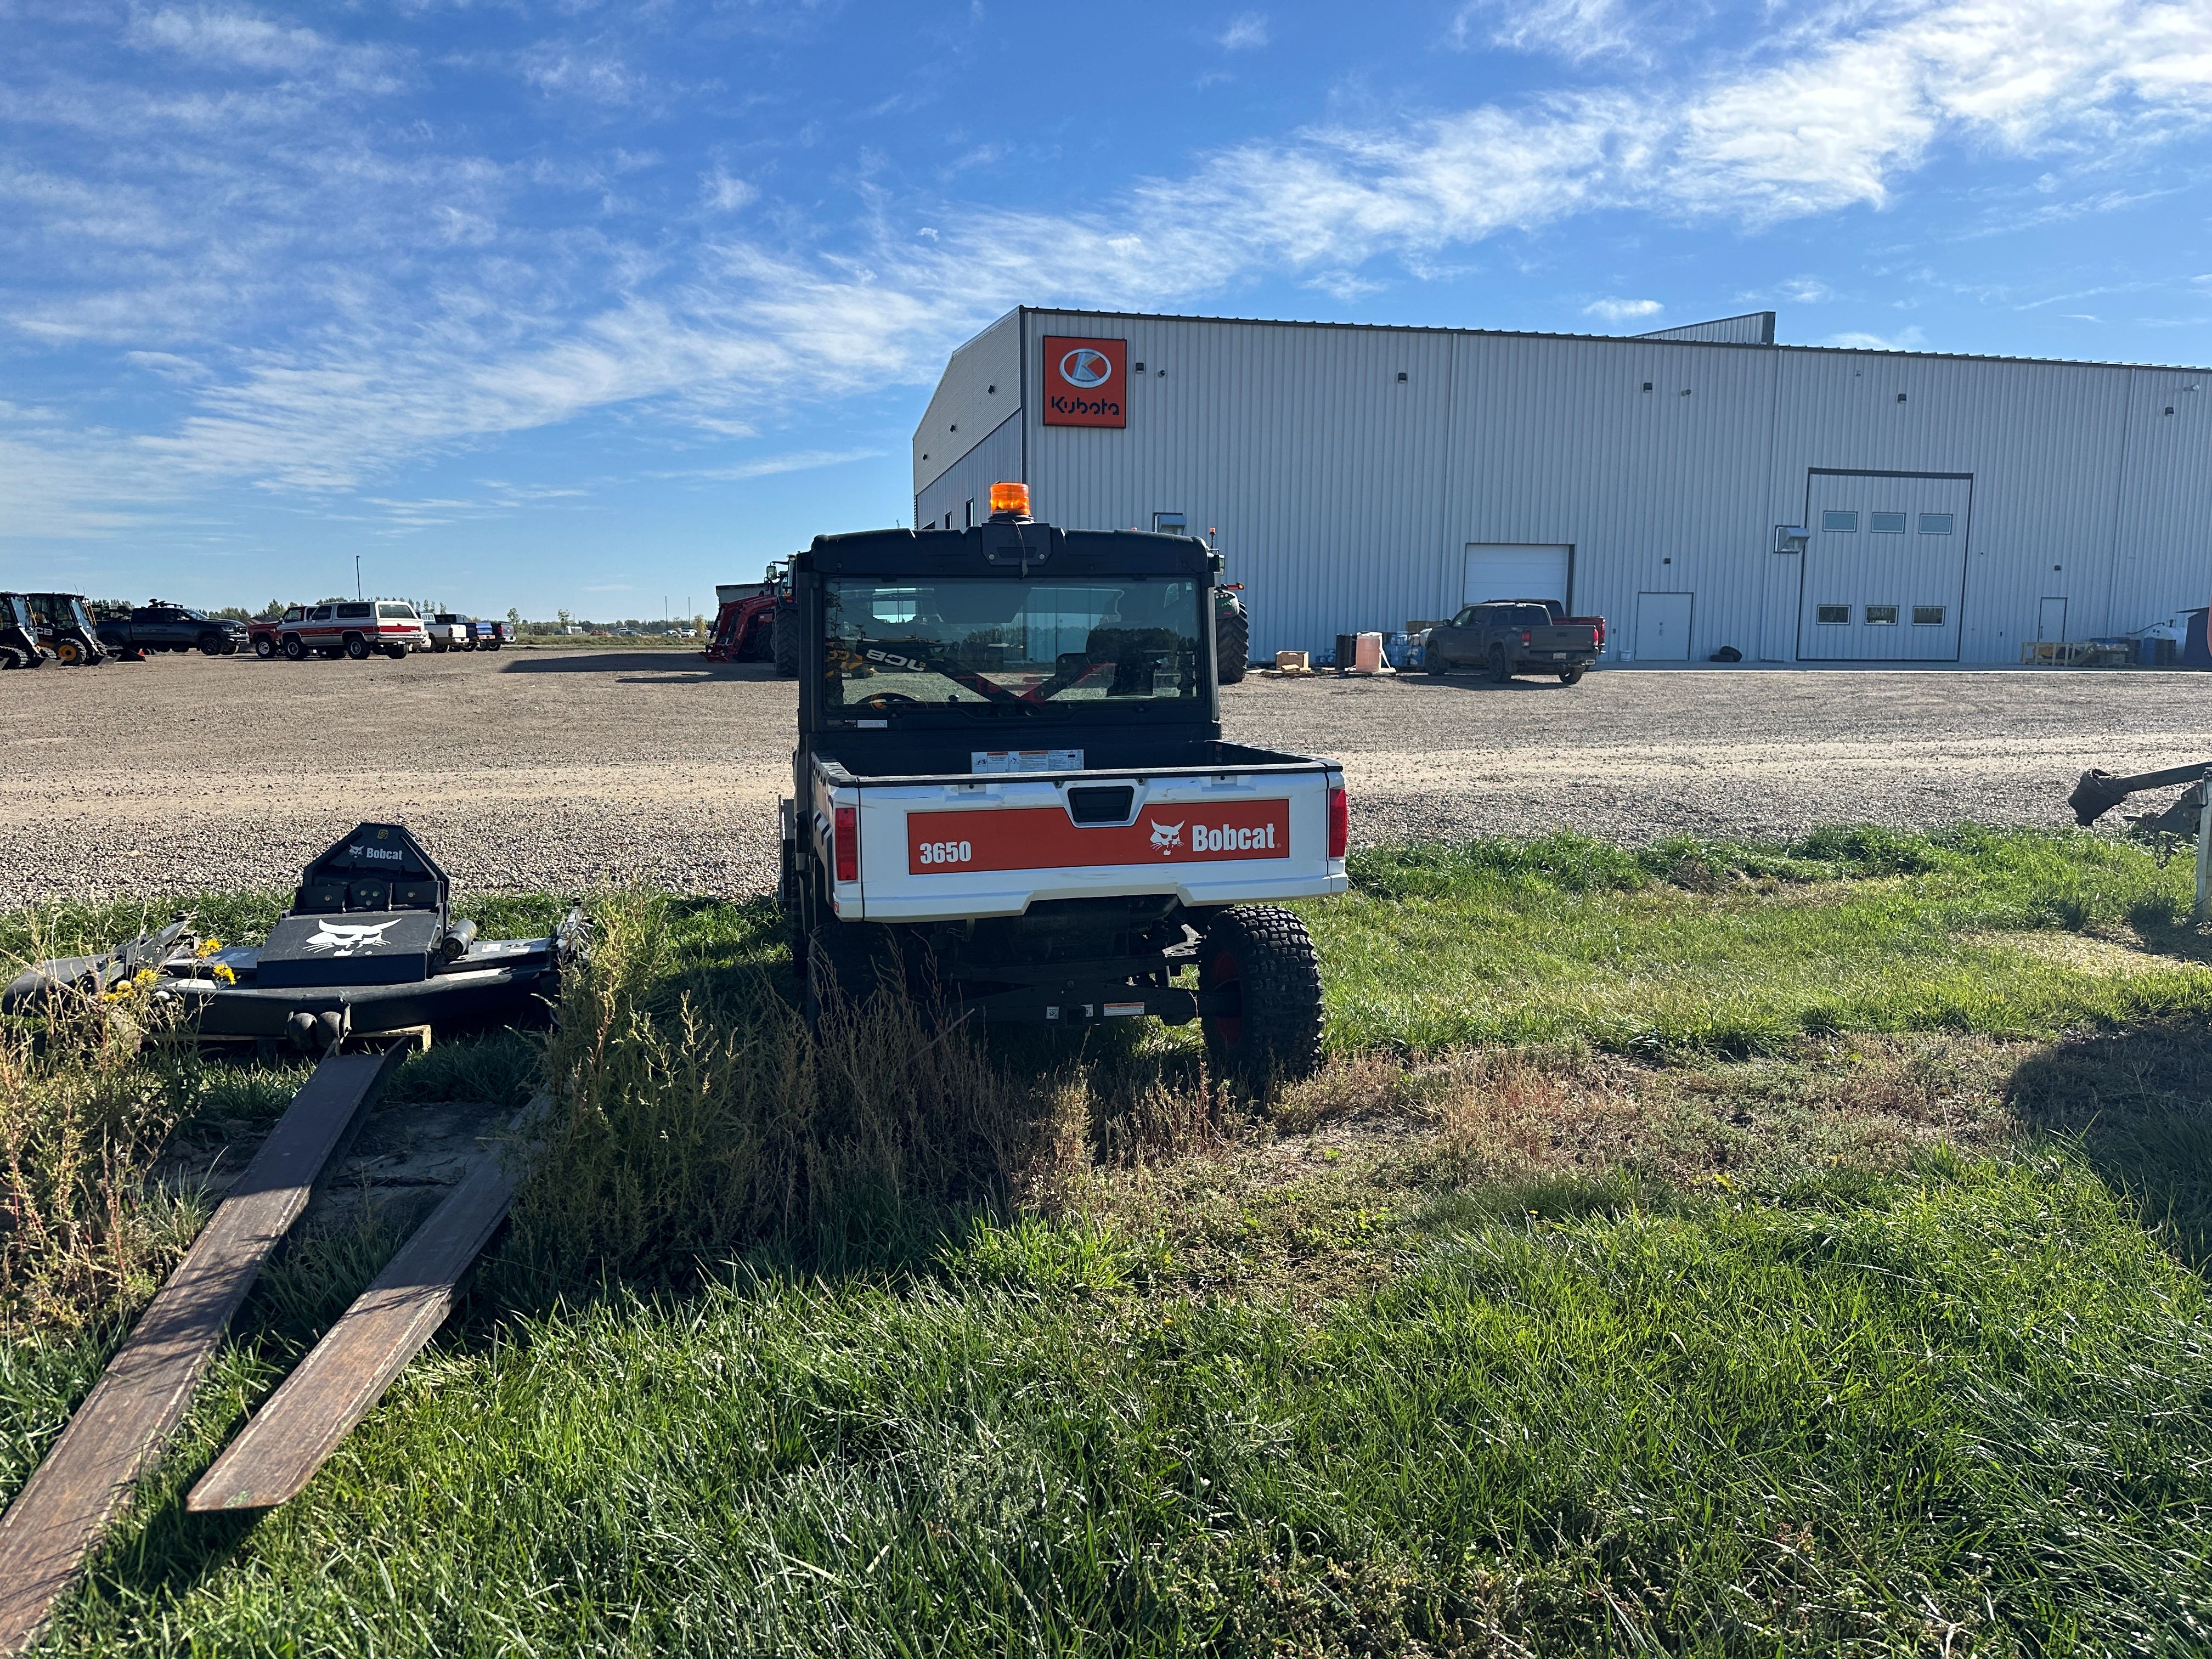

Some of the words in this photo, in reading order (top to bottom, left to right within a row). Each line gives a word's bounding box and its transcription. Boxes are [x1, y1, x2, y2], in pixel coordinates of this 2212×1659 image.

[1051, 396, 1120, 415] Kubota
[35, 627, 53, 636] CB
[1192, 823, 1275, 852] Bobcat
[366, 847, 403, 860] Bobcat
[919, 840, 972, 864] 3650
